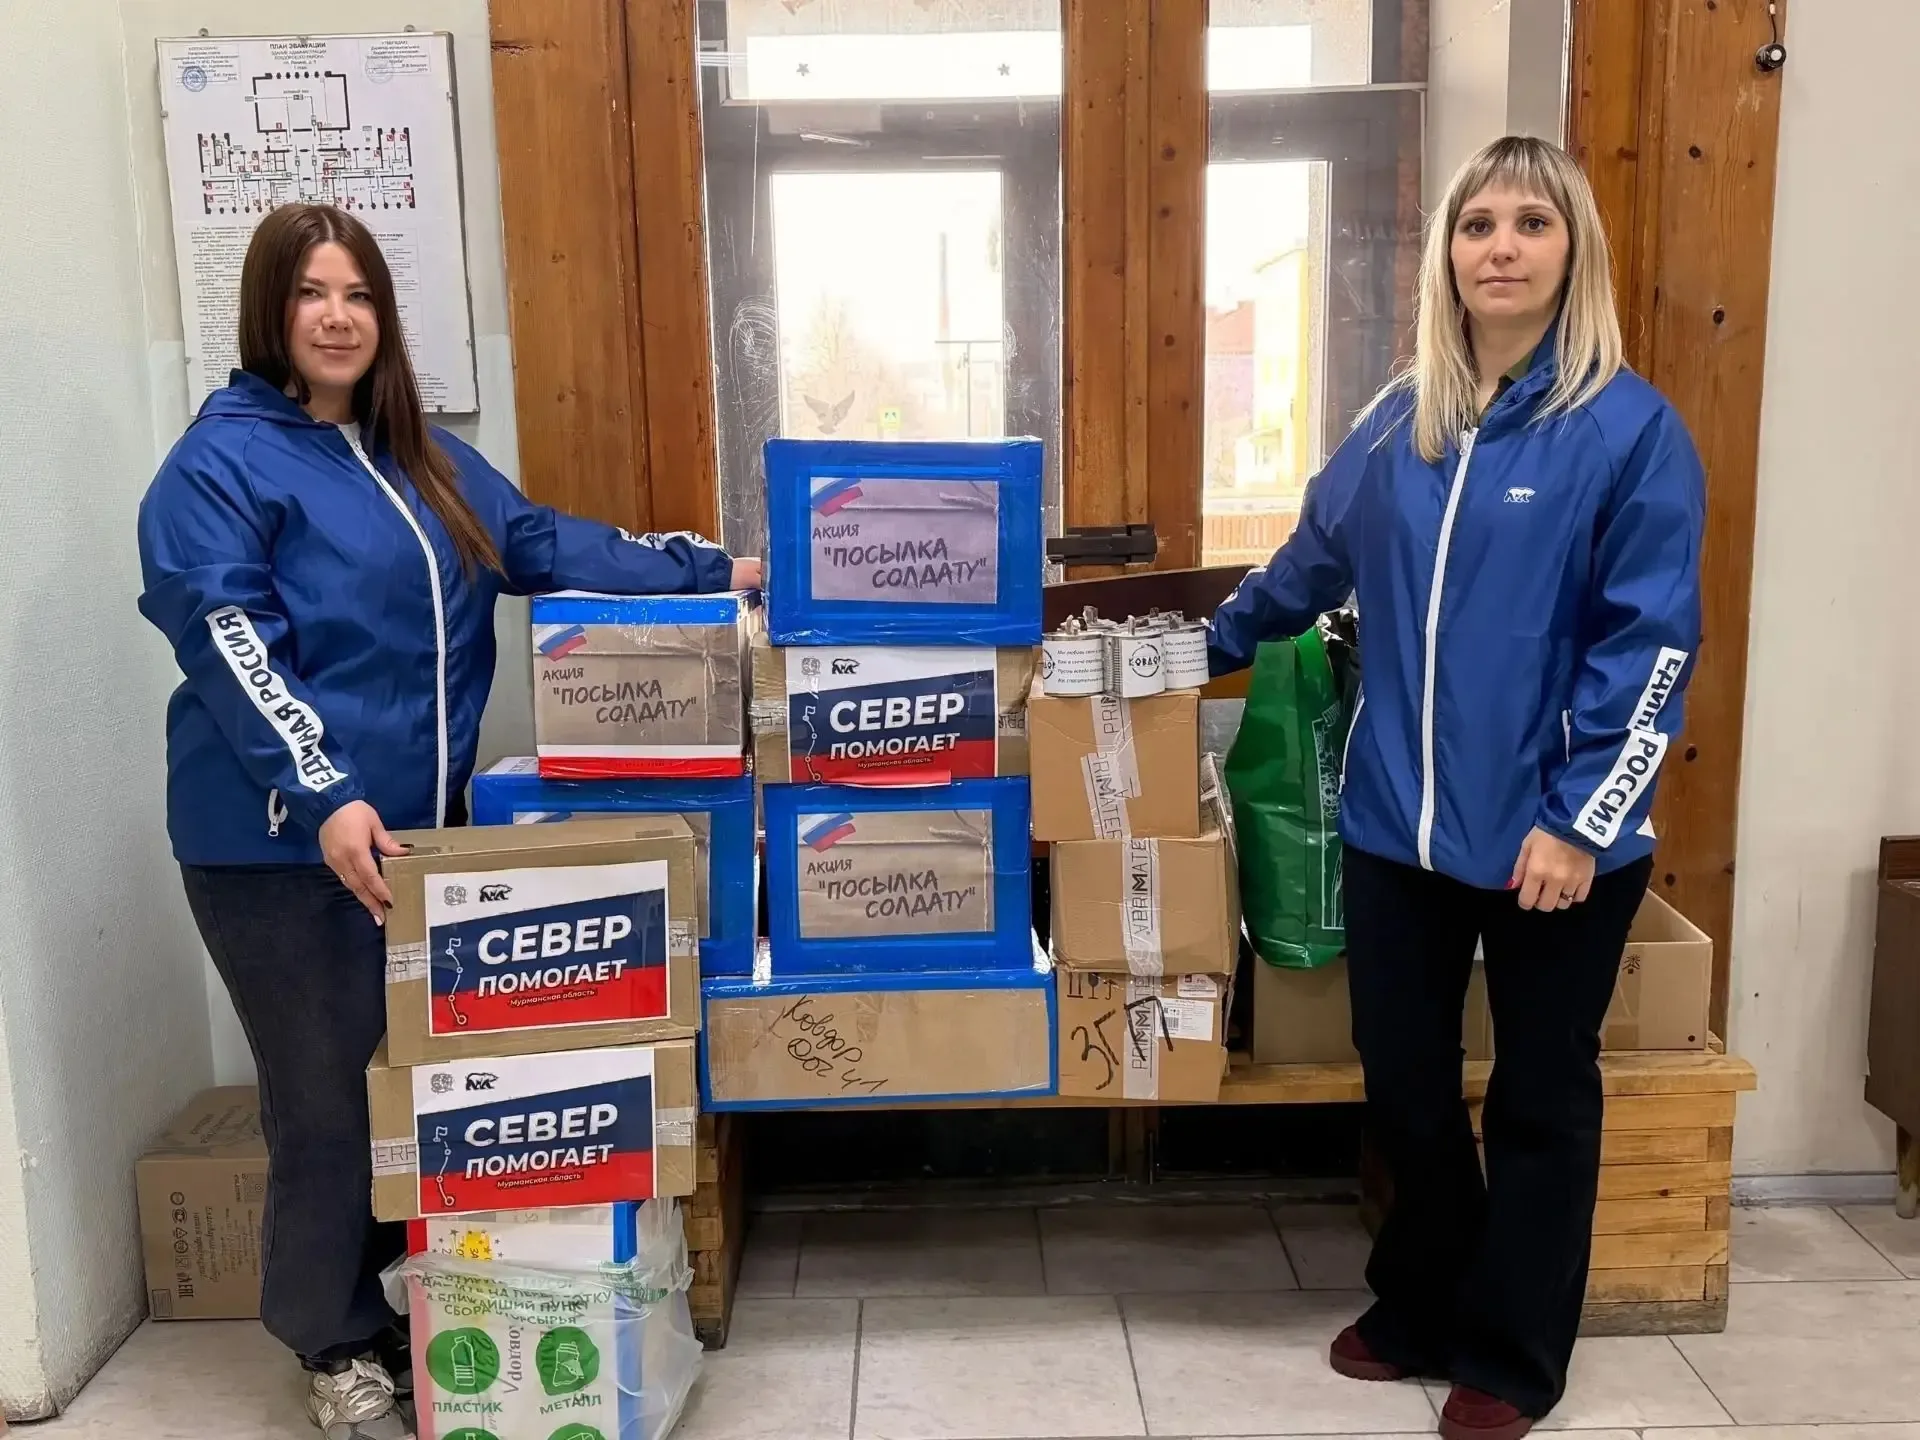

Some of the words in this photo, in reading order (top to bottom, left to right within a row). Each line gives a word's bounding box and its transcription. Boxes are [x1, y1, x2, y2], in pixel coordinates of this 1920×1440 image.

[812, 524, 860, 541] АКЦИЯ
[824, 538, 948, 568] "ПОСЫЛКА
[872, 557, 987, 589] СОЛДАТУ"
[215, 612, 282, 702] РОССИЯ
[542, 667, 585, 681] АКЦИЯ
[553, 680, 663, 706] "ПОСЫЛКА
[596, 696, 697, 724] СОЛДАТУ"
[829, 692, 965, 733] СЕВЕР
[830, 732, 961, 761] ПОМОГАЕТ
[856, 759, 903, 770] Мурманская
[903, 756, 933, 767] область
[1585, 737, 1659, 837] РОССИЯ
[807, 859, 853, 876] АКЦИЯ
[819, 869, 939, 901] "ПОСЫЛКА
[865, 886, 976, 919] СОЛДАТУ"
[477, 914, 633, 966] СЕВЕР
[478, 958, 628, 997] ПОМОГАЕТ
[509, 993, 561, 1008] Мурманская
[562, 988, 596, 1000] область
[463, 1102, 619, 1148] СЕВЕР
[465, 1143, 615, 1180] ПОМОГАЕТ
[496, 1175, 548, 1189] Мурманская
[549, 1171, 582, 1183] область
[444, 1304, 491, 1316] СБОРА
[432, 1402, 504, 1414] ПЛАСТИК
